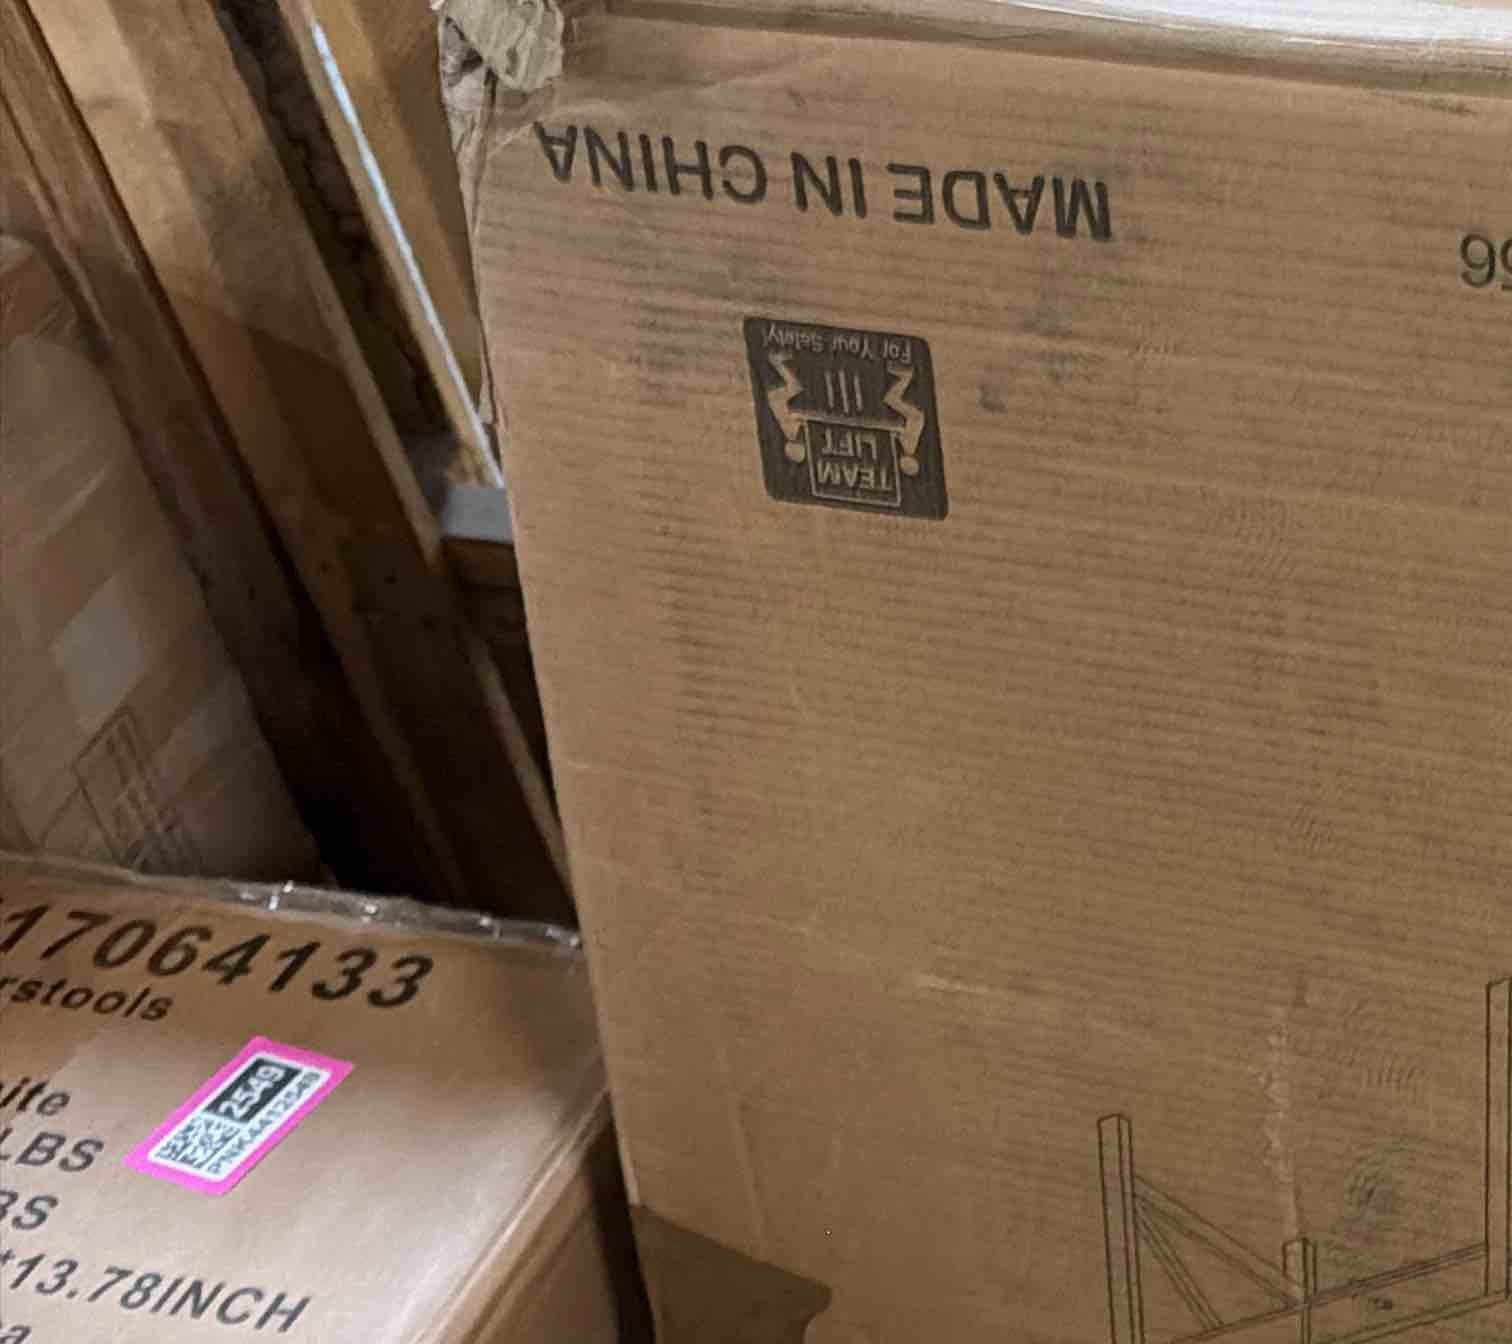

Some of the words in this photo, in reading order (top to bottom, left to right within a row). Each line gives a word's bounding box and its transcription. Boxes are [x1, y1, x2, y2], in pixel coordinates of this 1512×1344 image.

[534, 121, 768, 205] CHINA
[794, 152, 866, 218] IN
[888, 163, 1113, 242] MADE
[833, 336, 873, 359] Your
[883, 341, 912, 364] For
[822, 427, 877, 460] LIFT
[817, 459, 893, 491] TEAM
[0, 901, 434, 1008] 17064133
[0, 1077, 70, 1116] ite
[219, 1064, 286, 1123] 2549
